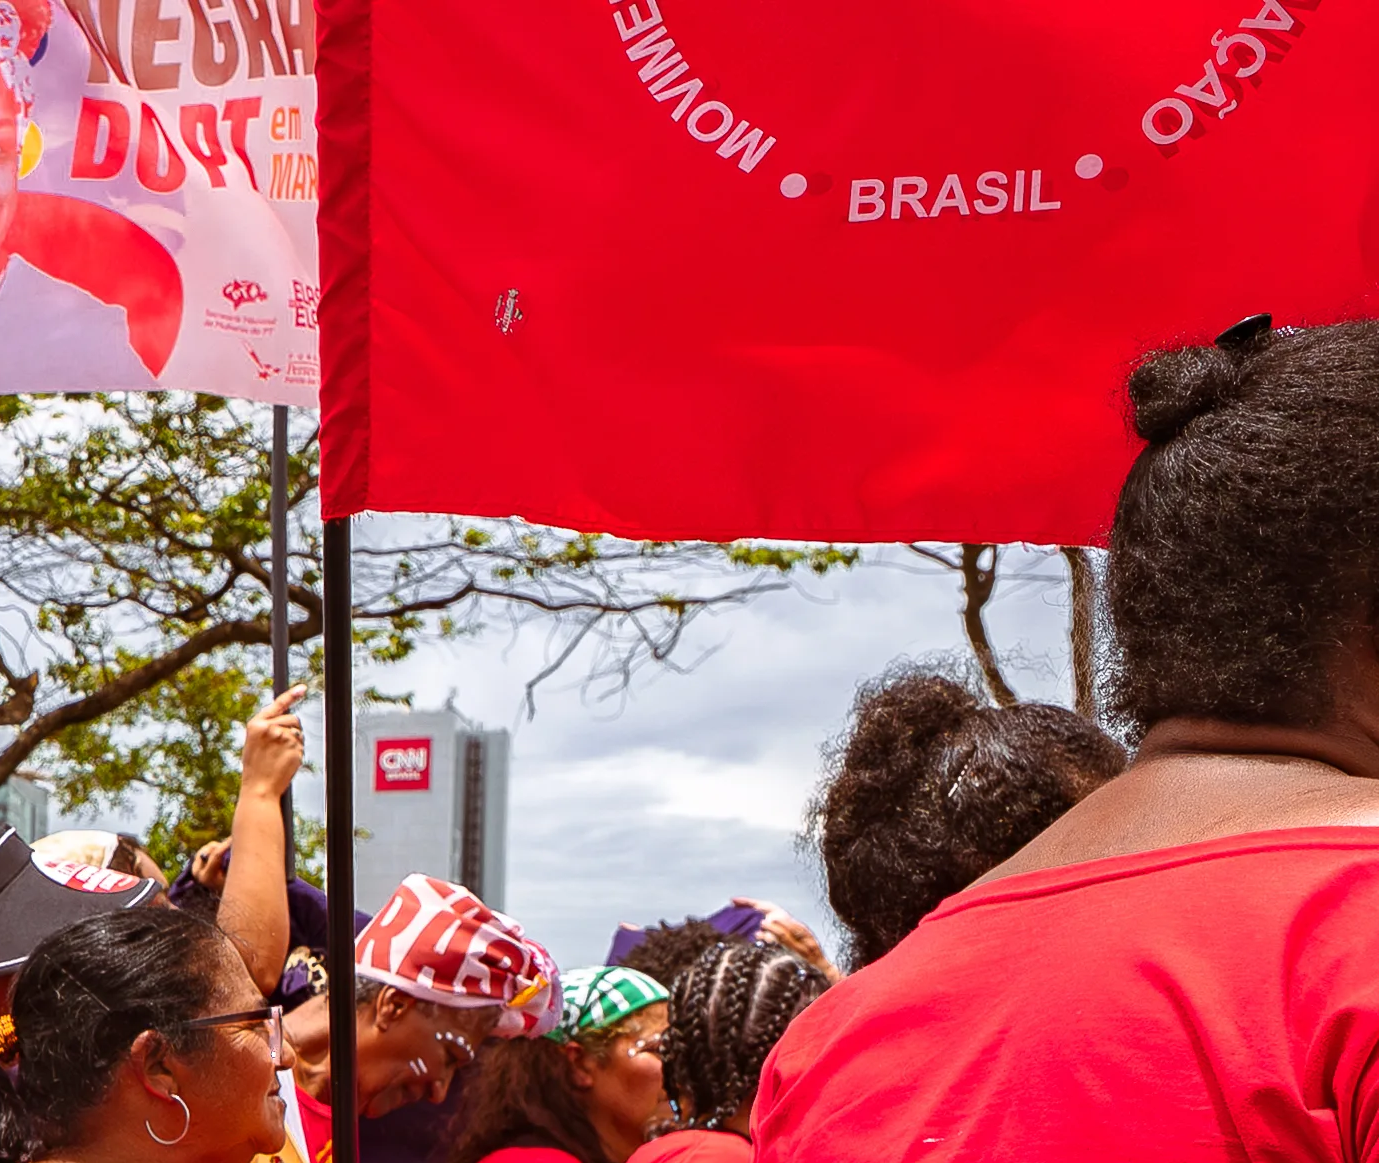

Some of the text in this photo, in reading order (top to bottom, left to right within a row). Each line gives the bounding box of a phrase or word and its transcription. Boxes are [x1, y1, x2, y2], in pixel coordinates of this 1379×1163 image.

[609, 0, 777, 174] MOVIME
[269, 106, 302, 141] em
[848, 169, 1061, 222] BRASIL
[379, 747, 427, 772] CNN
